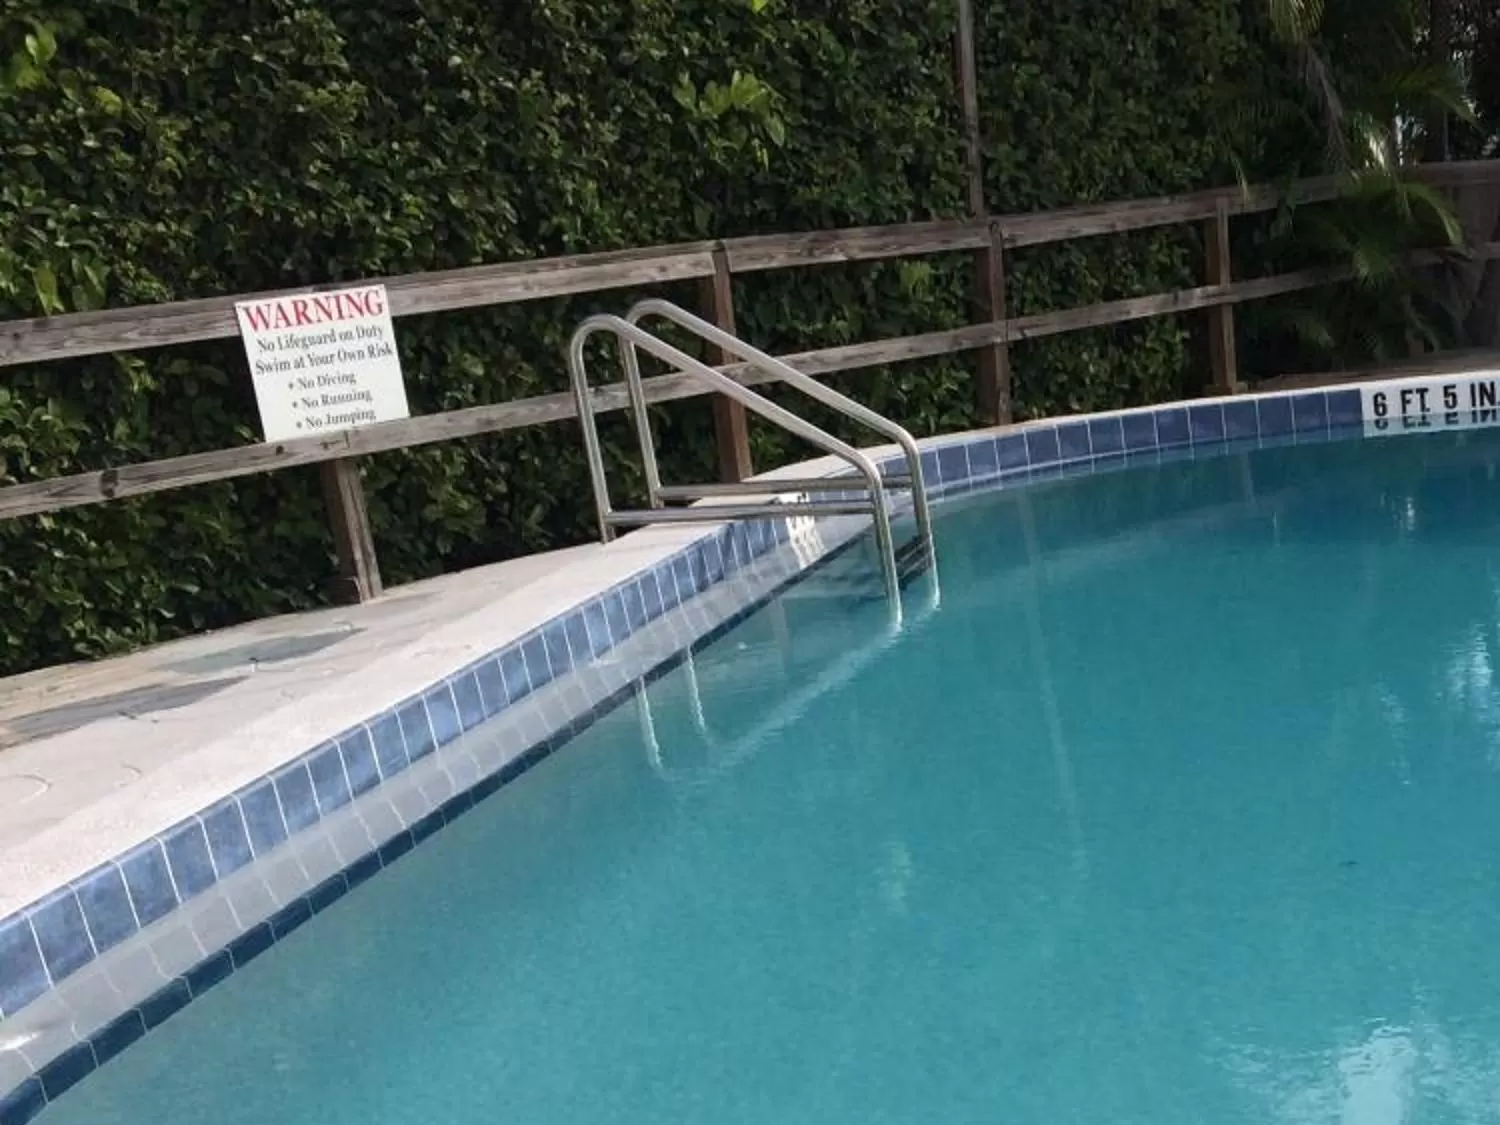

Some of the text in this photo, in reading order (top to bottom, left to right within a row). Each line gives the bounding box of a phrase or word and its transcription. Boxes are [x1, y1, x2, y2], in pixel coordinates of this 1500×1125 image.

[244, 290, 383, 332] WARNING
[257, 324, 384, 352] No Lifeguard on Duty
[256, 343, 393, 375] Swim at Your Own Risk
[298, 372, 357, 389] No Diving
[302, 389, 373, 409] No Running
[1373, 392, 1387, 417] 6
[1443, 384, 1457, 409] 5
[306, 408, 377, 428] No Jumping
